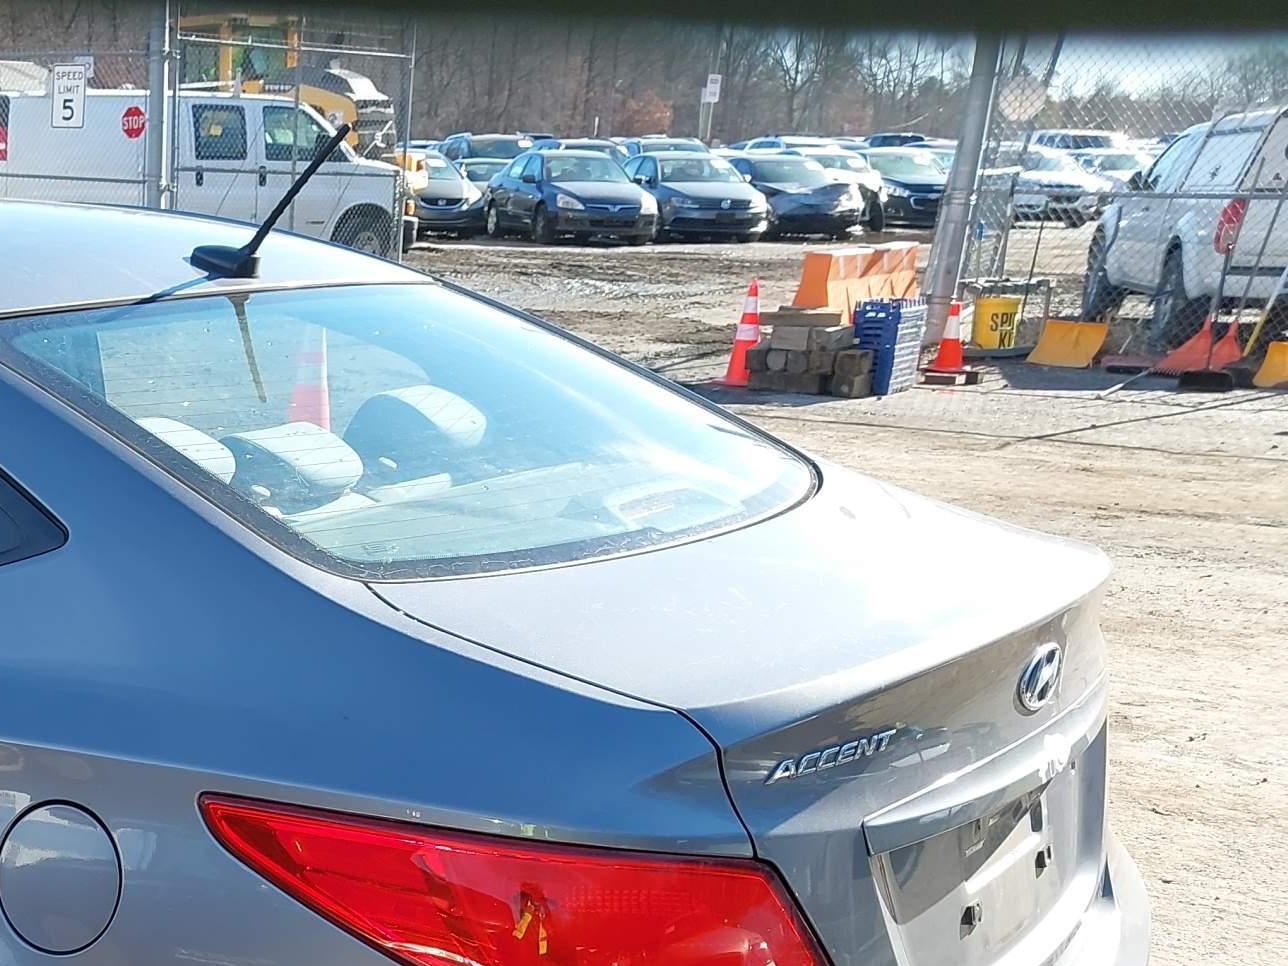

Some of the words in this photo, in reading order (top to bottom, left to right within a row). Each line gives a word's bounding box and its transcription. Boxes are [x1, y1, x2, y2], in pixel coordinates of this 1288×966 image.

[55, 71, 83, 81] SPEED
[57, 84, 80, 94] LIMIT
[61, 98, 74, 121] 5
[123, 115, 144, 130] STOP
[763, 728, 897, 785] ACCENT
